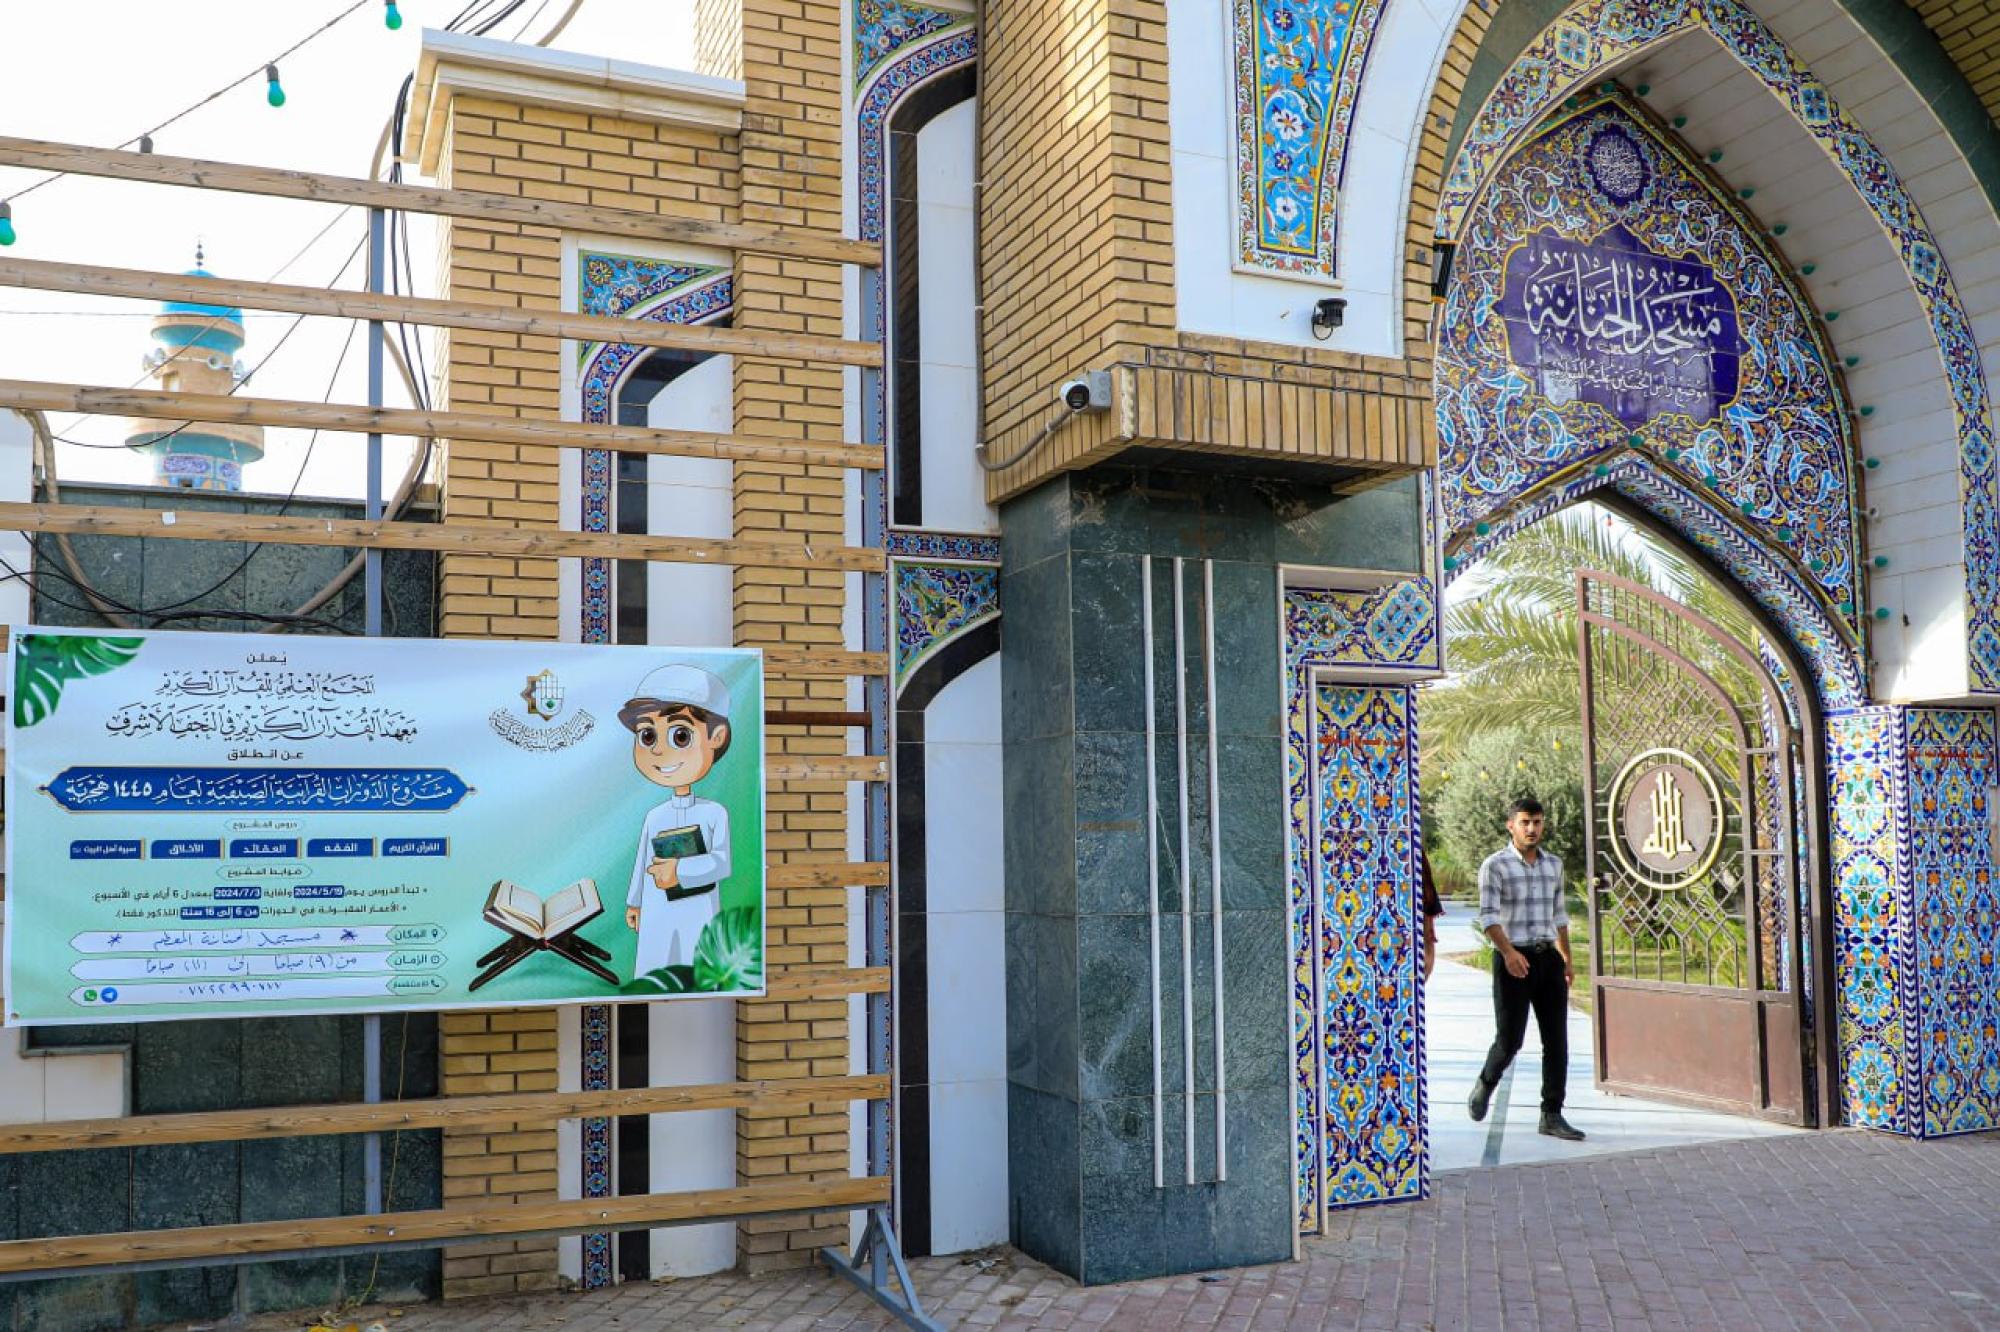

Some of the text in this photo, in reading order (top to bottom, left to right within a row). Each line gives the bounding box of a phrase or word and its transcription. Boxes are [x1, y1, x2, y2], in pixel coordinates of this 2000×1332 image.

[281, 750, 304, 761] عن
[113, 779, 152, 798] ١٤٤٥
[324, 842, 358, 853] الفقه
